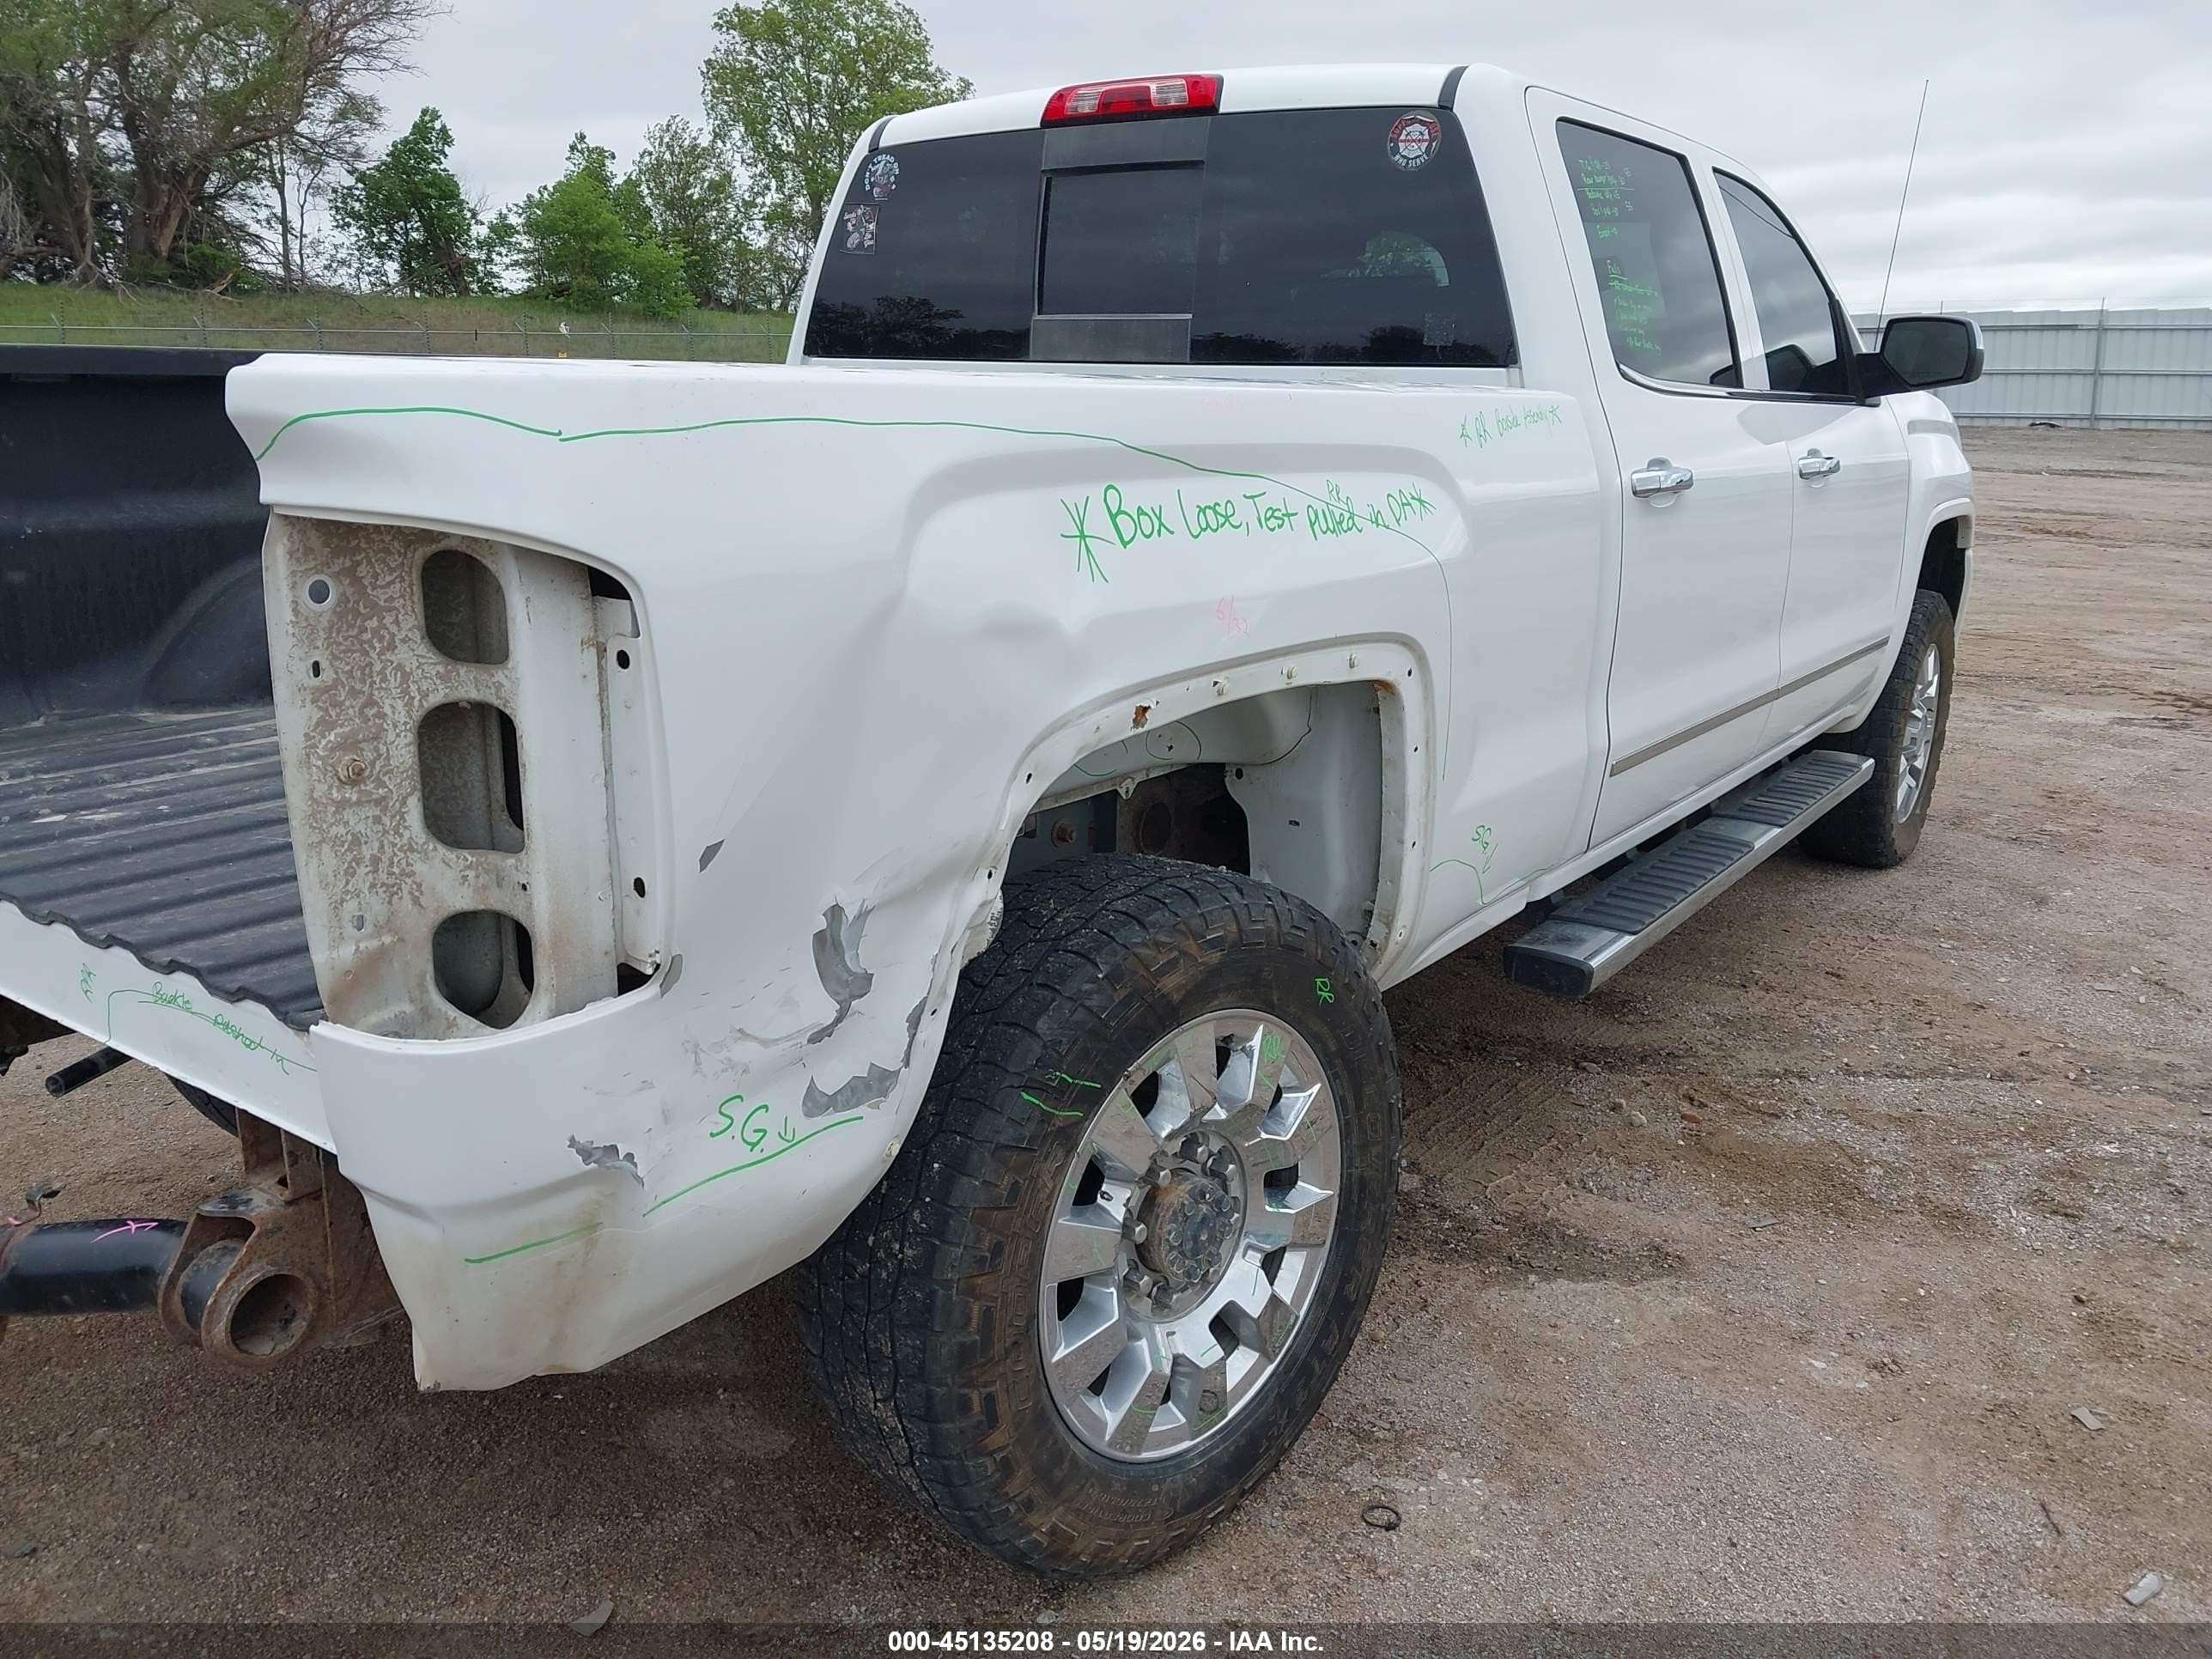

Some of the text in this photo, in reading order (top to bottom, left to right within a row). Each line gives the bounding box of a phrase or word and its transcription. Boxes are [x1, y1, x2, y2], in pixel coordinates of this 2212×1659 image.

[872, 154, 895, 164] TREAD
[892, 161, 900, 175] ON
[1394, 154, 1431, 167] WHO SERVE
[1103, 483, 1175, 550] Box
[1242, 490, 1299, 532] Test
[1366, 503, 1390, 529] in
